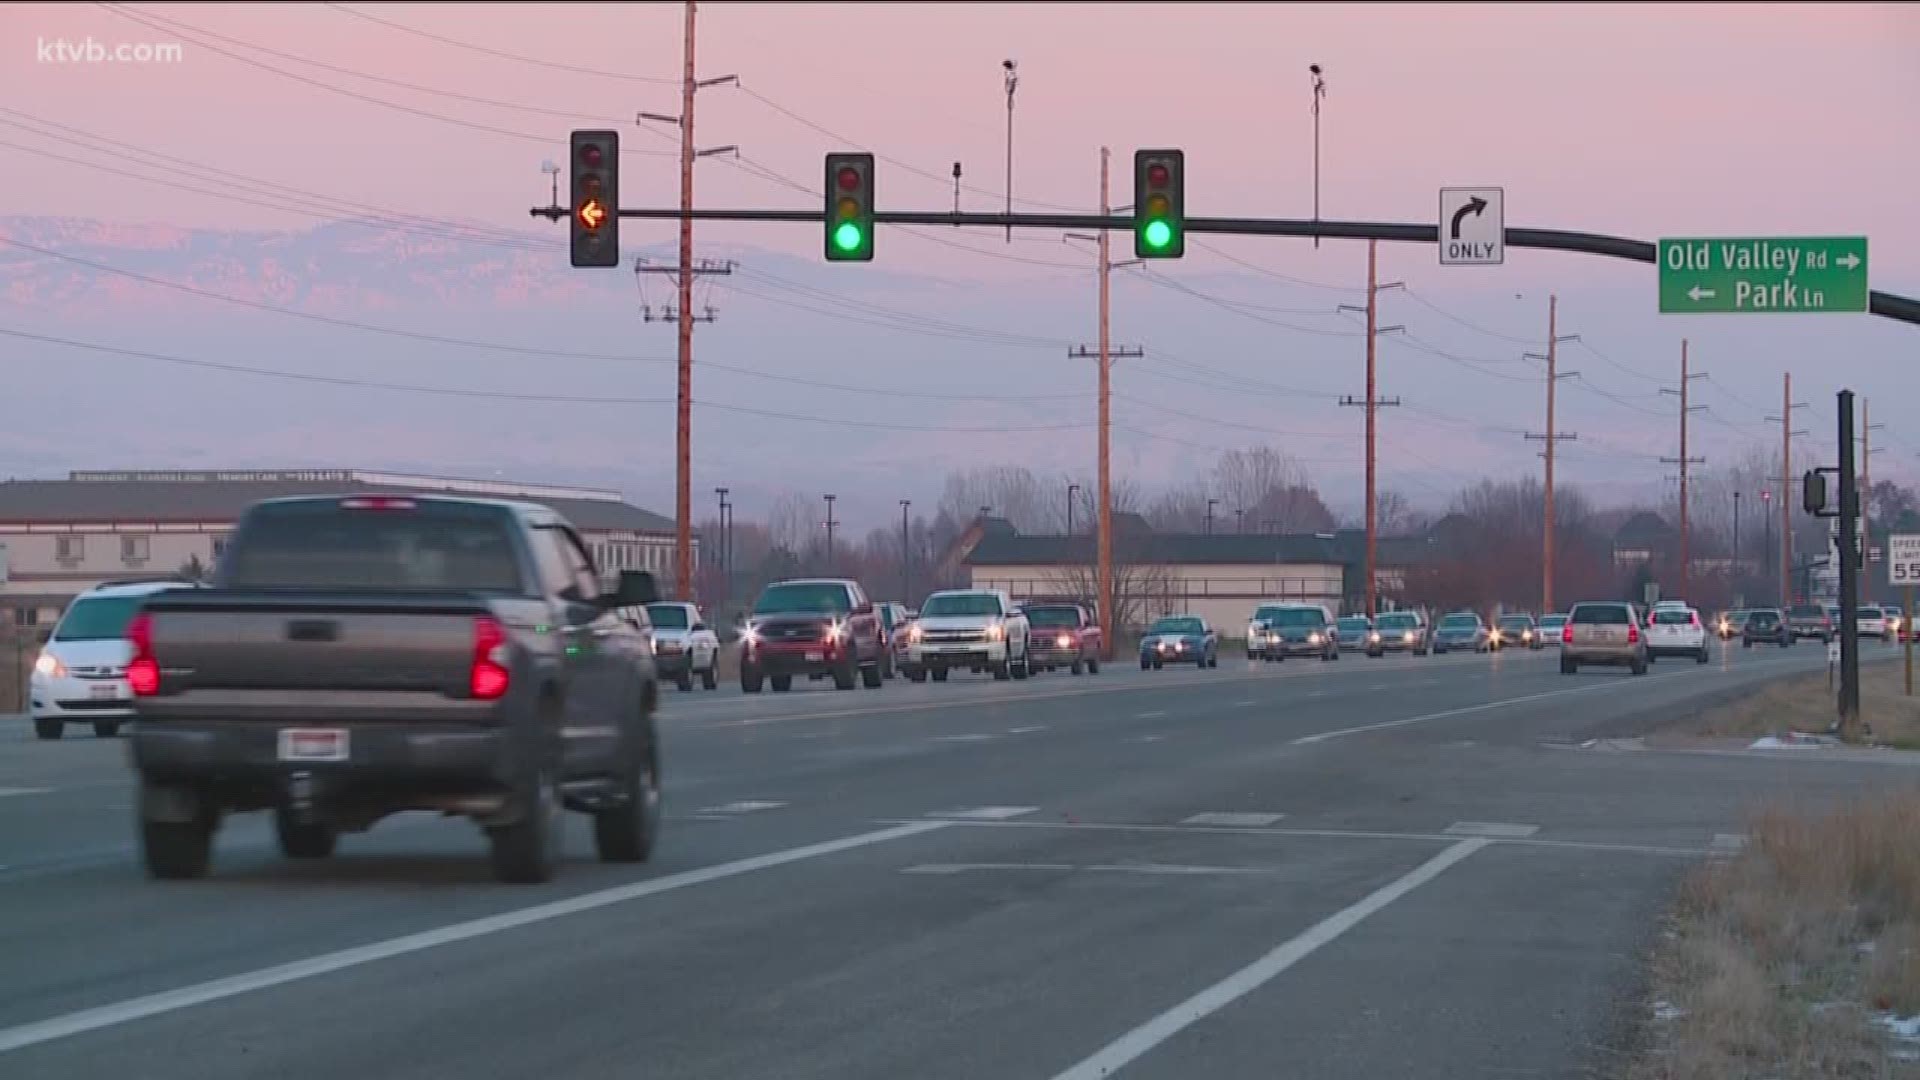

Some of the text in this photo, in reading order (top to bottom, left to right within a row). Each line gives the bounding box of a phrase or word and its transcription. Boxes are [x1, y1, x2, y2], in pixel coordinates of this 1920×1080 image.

[1449, 242, 1494, 258] ONLY
[1667, 242, 1827, 276] Old Valley Rd
[1736, 279, 1824, 308] Park Ln
[1895, 563, 1920, 578] 55
